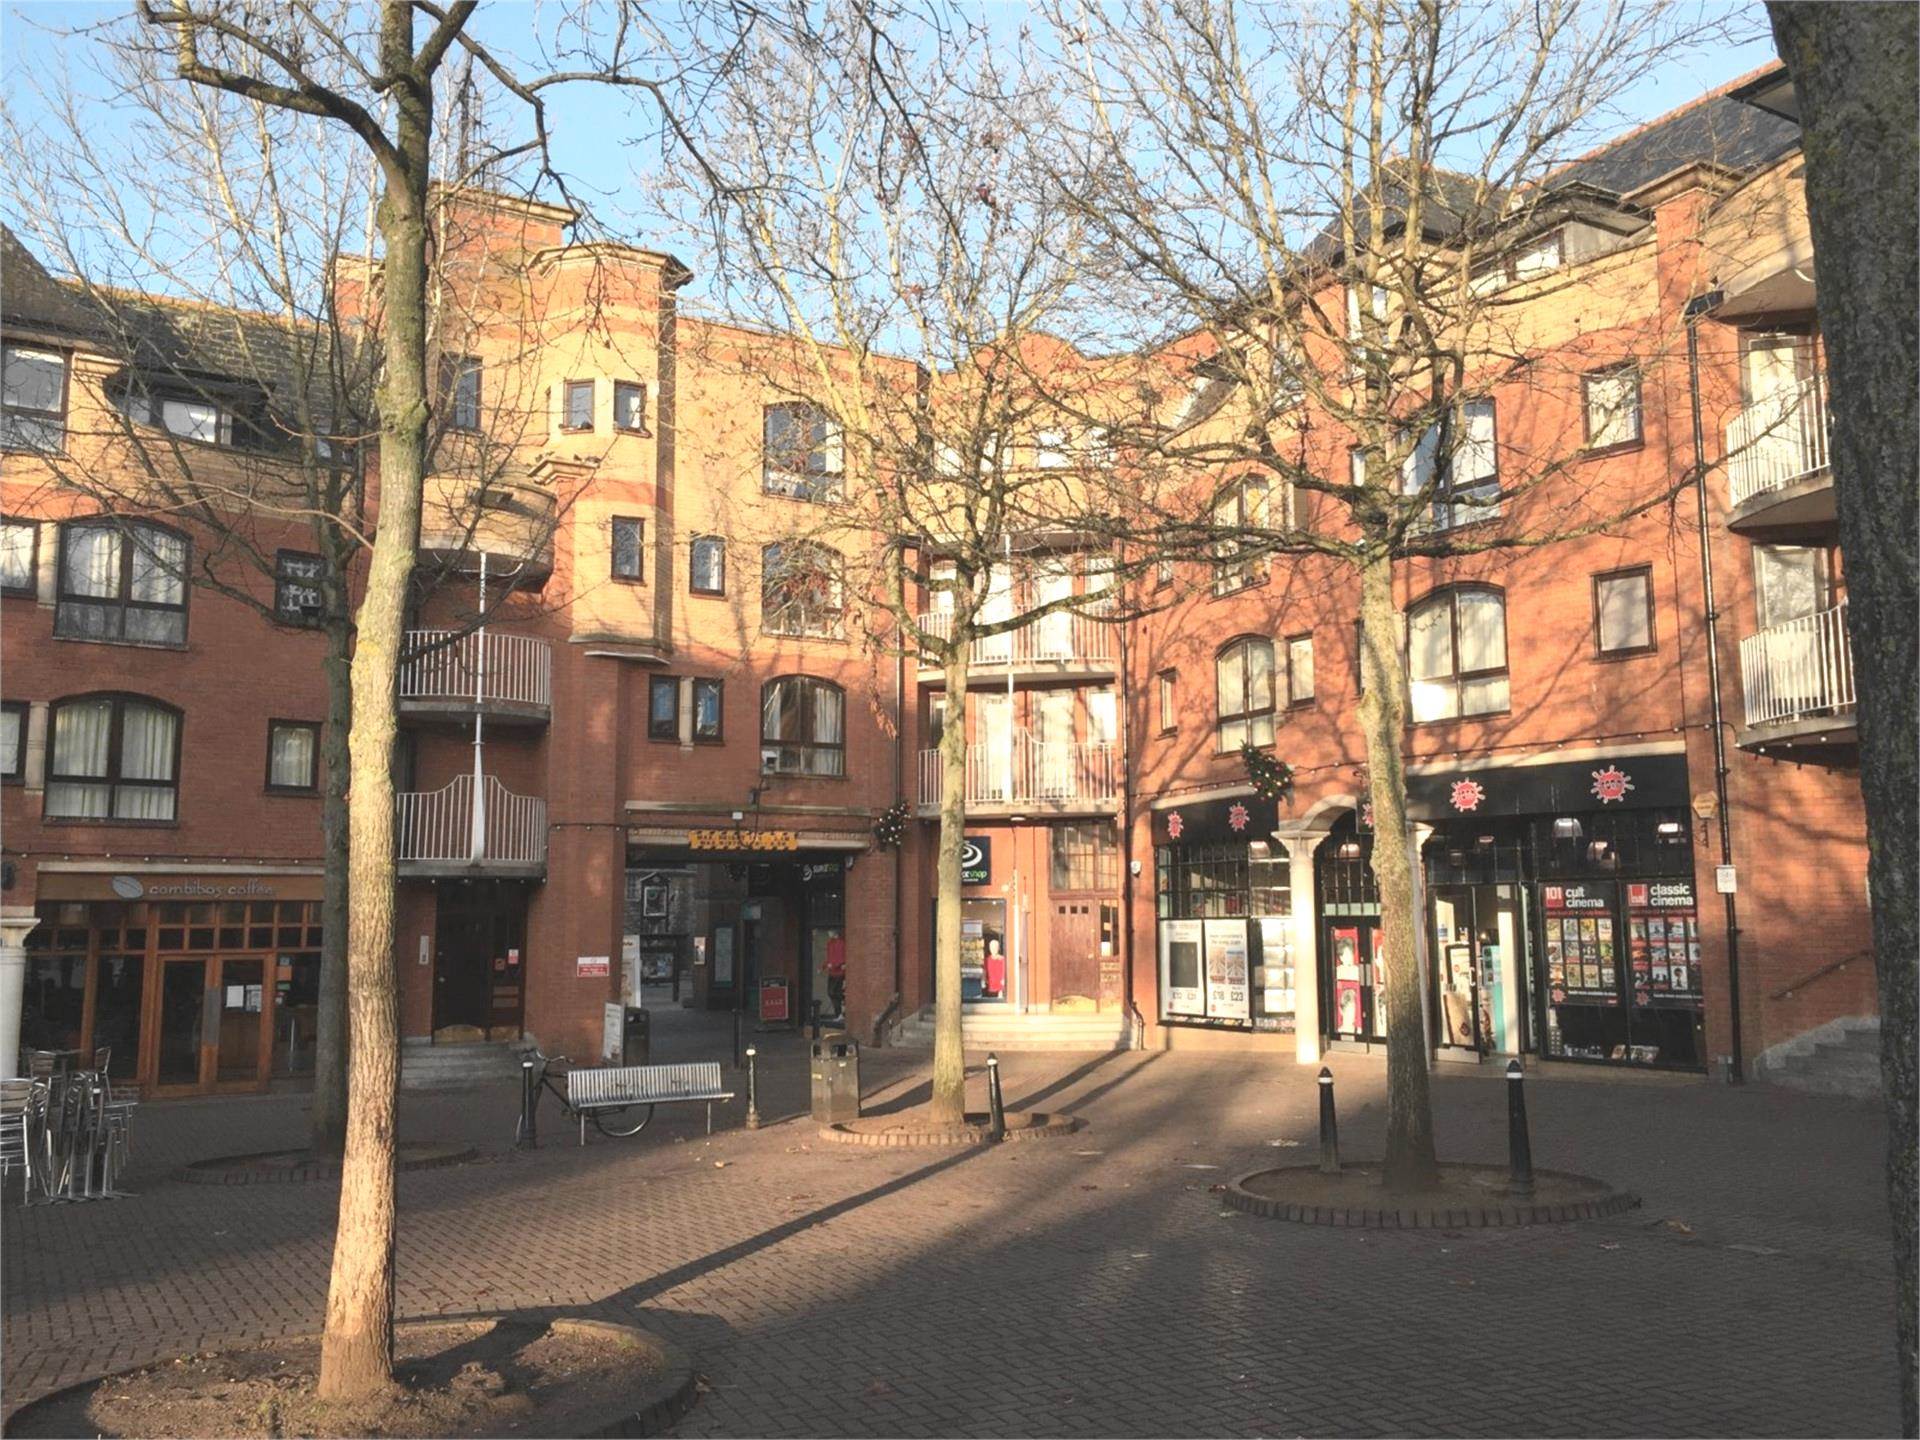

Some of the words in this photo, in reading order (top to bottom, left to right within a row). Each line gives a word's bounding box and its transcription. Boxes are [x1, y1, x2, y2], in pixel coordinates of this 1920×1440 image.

[1545, 886, 1562, 899] 101
[1565, 886, 1585, 898] cult
[1650, 883, 1690, 897] classic
[1565, 897, 1604, 908] cinema
[1650, 895, 1694, 907] cinema
